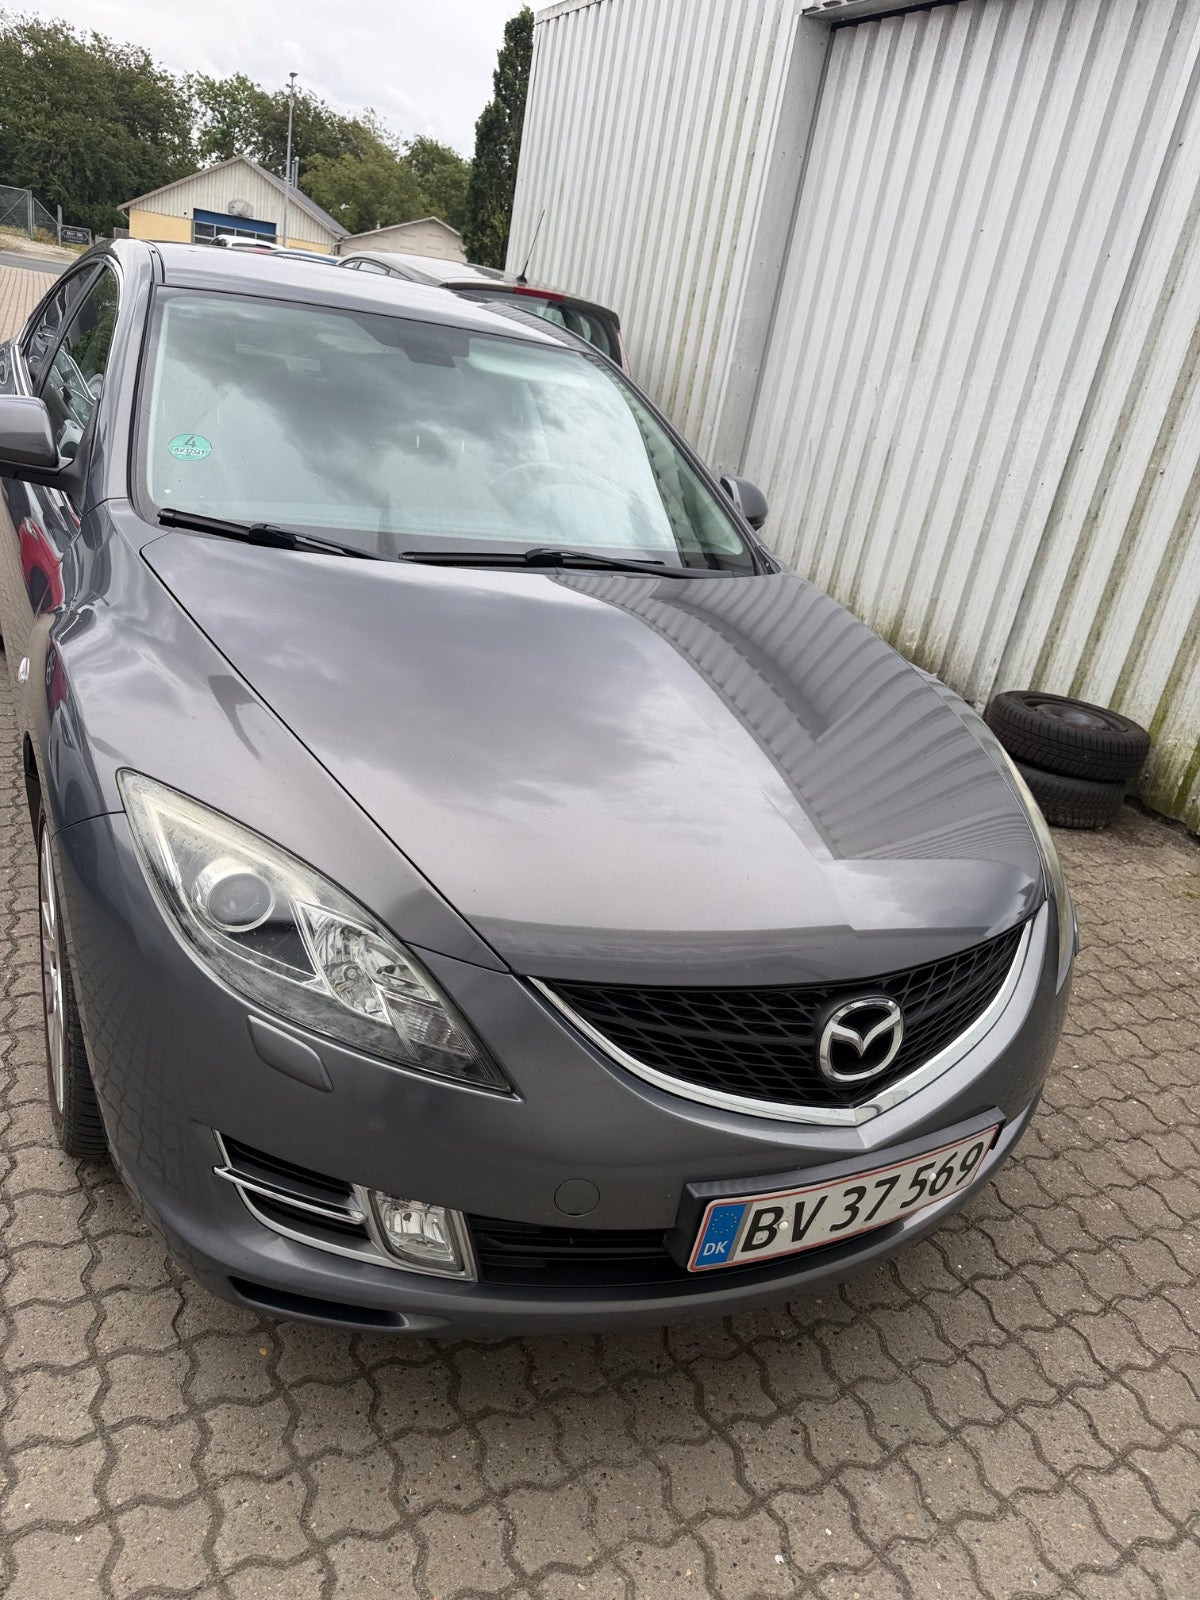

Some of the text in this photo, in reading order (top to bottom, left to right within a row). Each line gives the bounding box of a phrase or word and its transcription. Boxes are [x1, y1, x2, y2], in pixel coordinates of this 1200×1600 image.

[184, 435, 197, 448] 4
[740, 1195, 828, 1253] BV
[702, 1240, 728, 1258] DK
